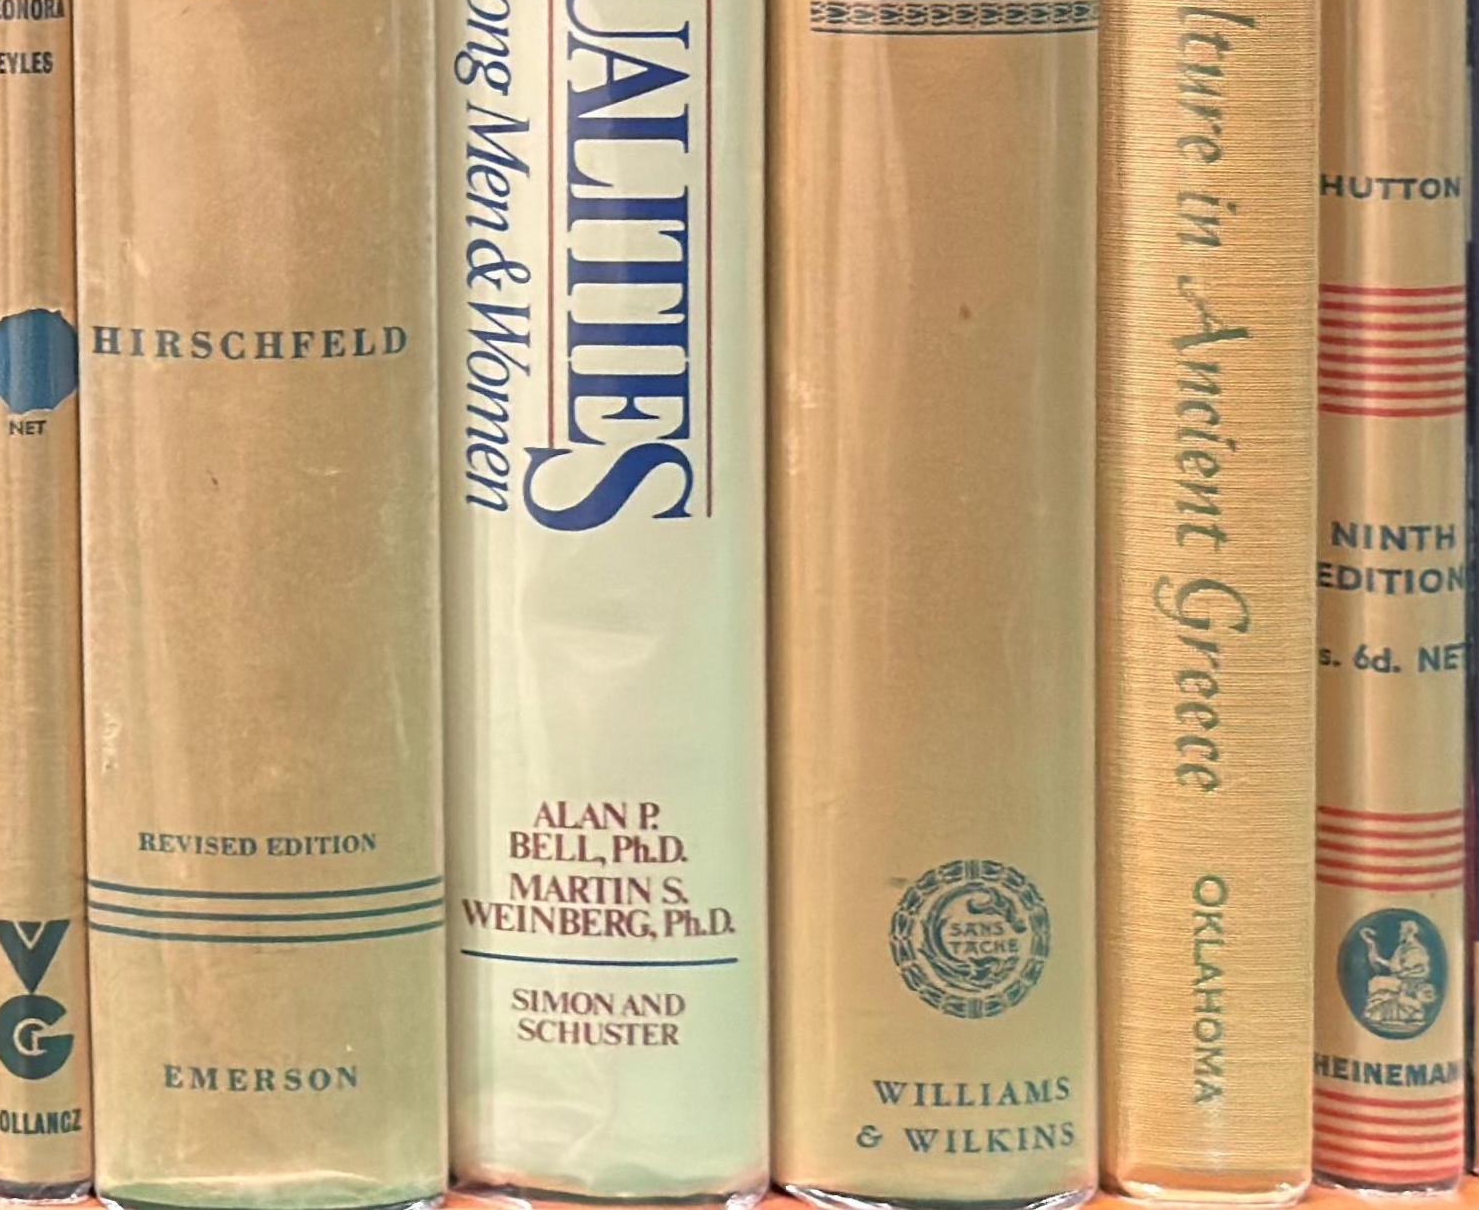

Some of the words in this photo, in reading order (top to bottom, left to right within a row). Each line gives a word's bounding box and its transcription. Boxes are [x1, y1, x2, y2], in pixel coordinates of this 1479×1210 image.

[465, 101, 530, 225] Men
[1320, 174, 1461, 200] HUTTON
[92, 326, 407, 360] HIRSCHFELD
[466, 303, 531, 512] Women
[1170, 274, 1253, 549] Ancient
[9, 420, 47, 435] NET
[1331, 521, 1456, 551] NINTH
[1316, 561, 1468, 594] EDITION
[1152, 574, 1251, 795] Greece
[533, 800, 627, 830] ALAN
[138, 833, 257, 856] REVISED
[266, 833, 377, 856] EDITION
[612, 835, 688, 863] Ph.D.
[509, 873, 651, 905] MARTIN
[511, 989, 614, 1015] SIMON
[621, 993, 686, 1017] AND
[1191, 873, 1230, 1106] OKLAHOMA
[517, 1019, 679, 1046] SCHUSTER
[164, 1064, 358, 1091] EMERSON
[873, 1076, 1070, 1107] WILLIAMS
[904, 1122, 1075, 1154] WILKINS
